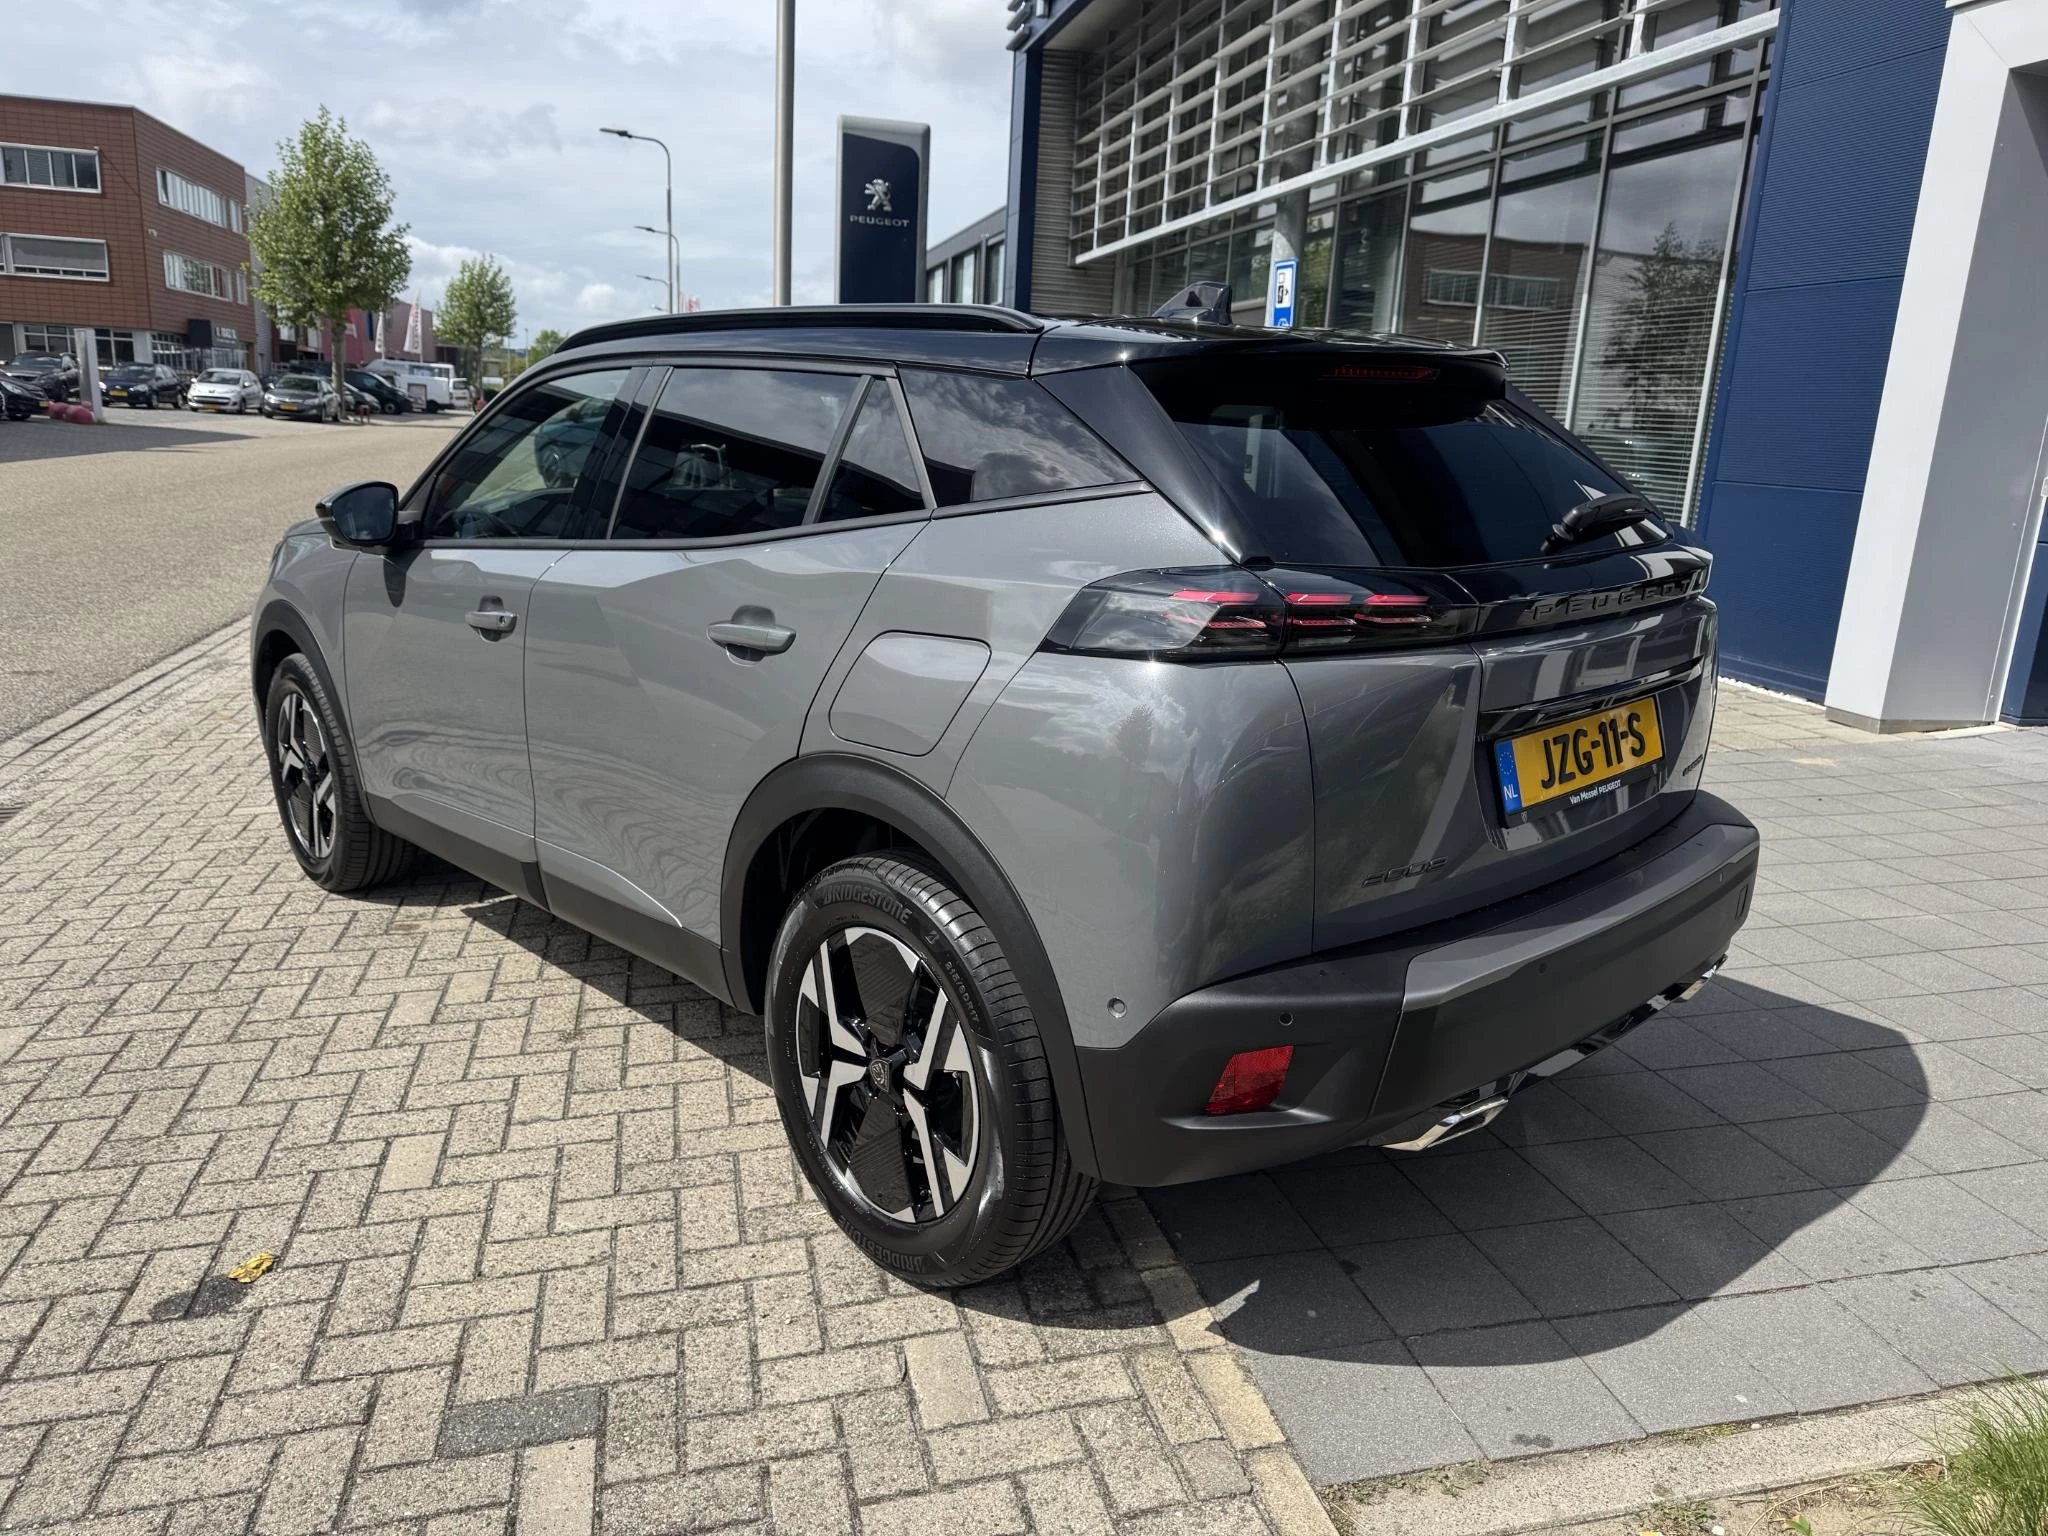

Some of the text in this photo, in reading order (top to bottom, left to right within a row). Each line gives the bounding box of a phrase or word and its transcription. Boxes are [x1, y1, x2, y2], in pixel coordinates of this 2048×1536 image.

[850, 214, 910, 227] PEUGEOT
[1532, 579, 1691, 621] PEUGEOT
[1541, 712, 1646, 789] JZG-11-S
[1503, 783, 1518, 801] NL
[1570, 779, 1621, 805] Van Mossel PEUGEOT
[823, 884, 913, 924] BRIDGESTONE
[838, 1215, 926, 1274] BRIDGESTONE
